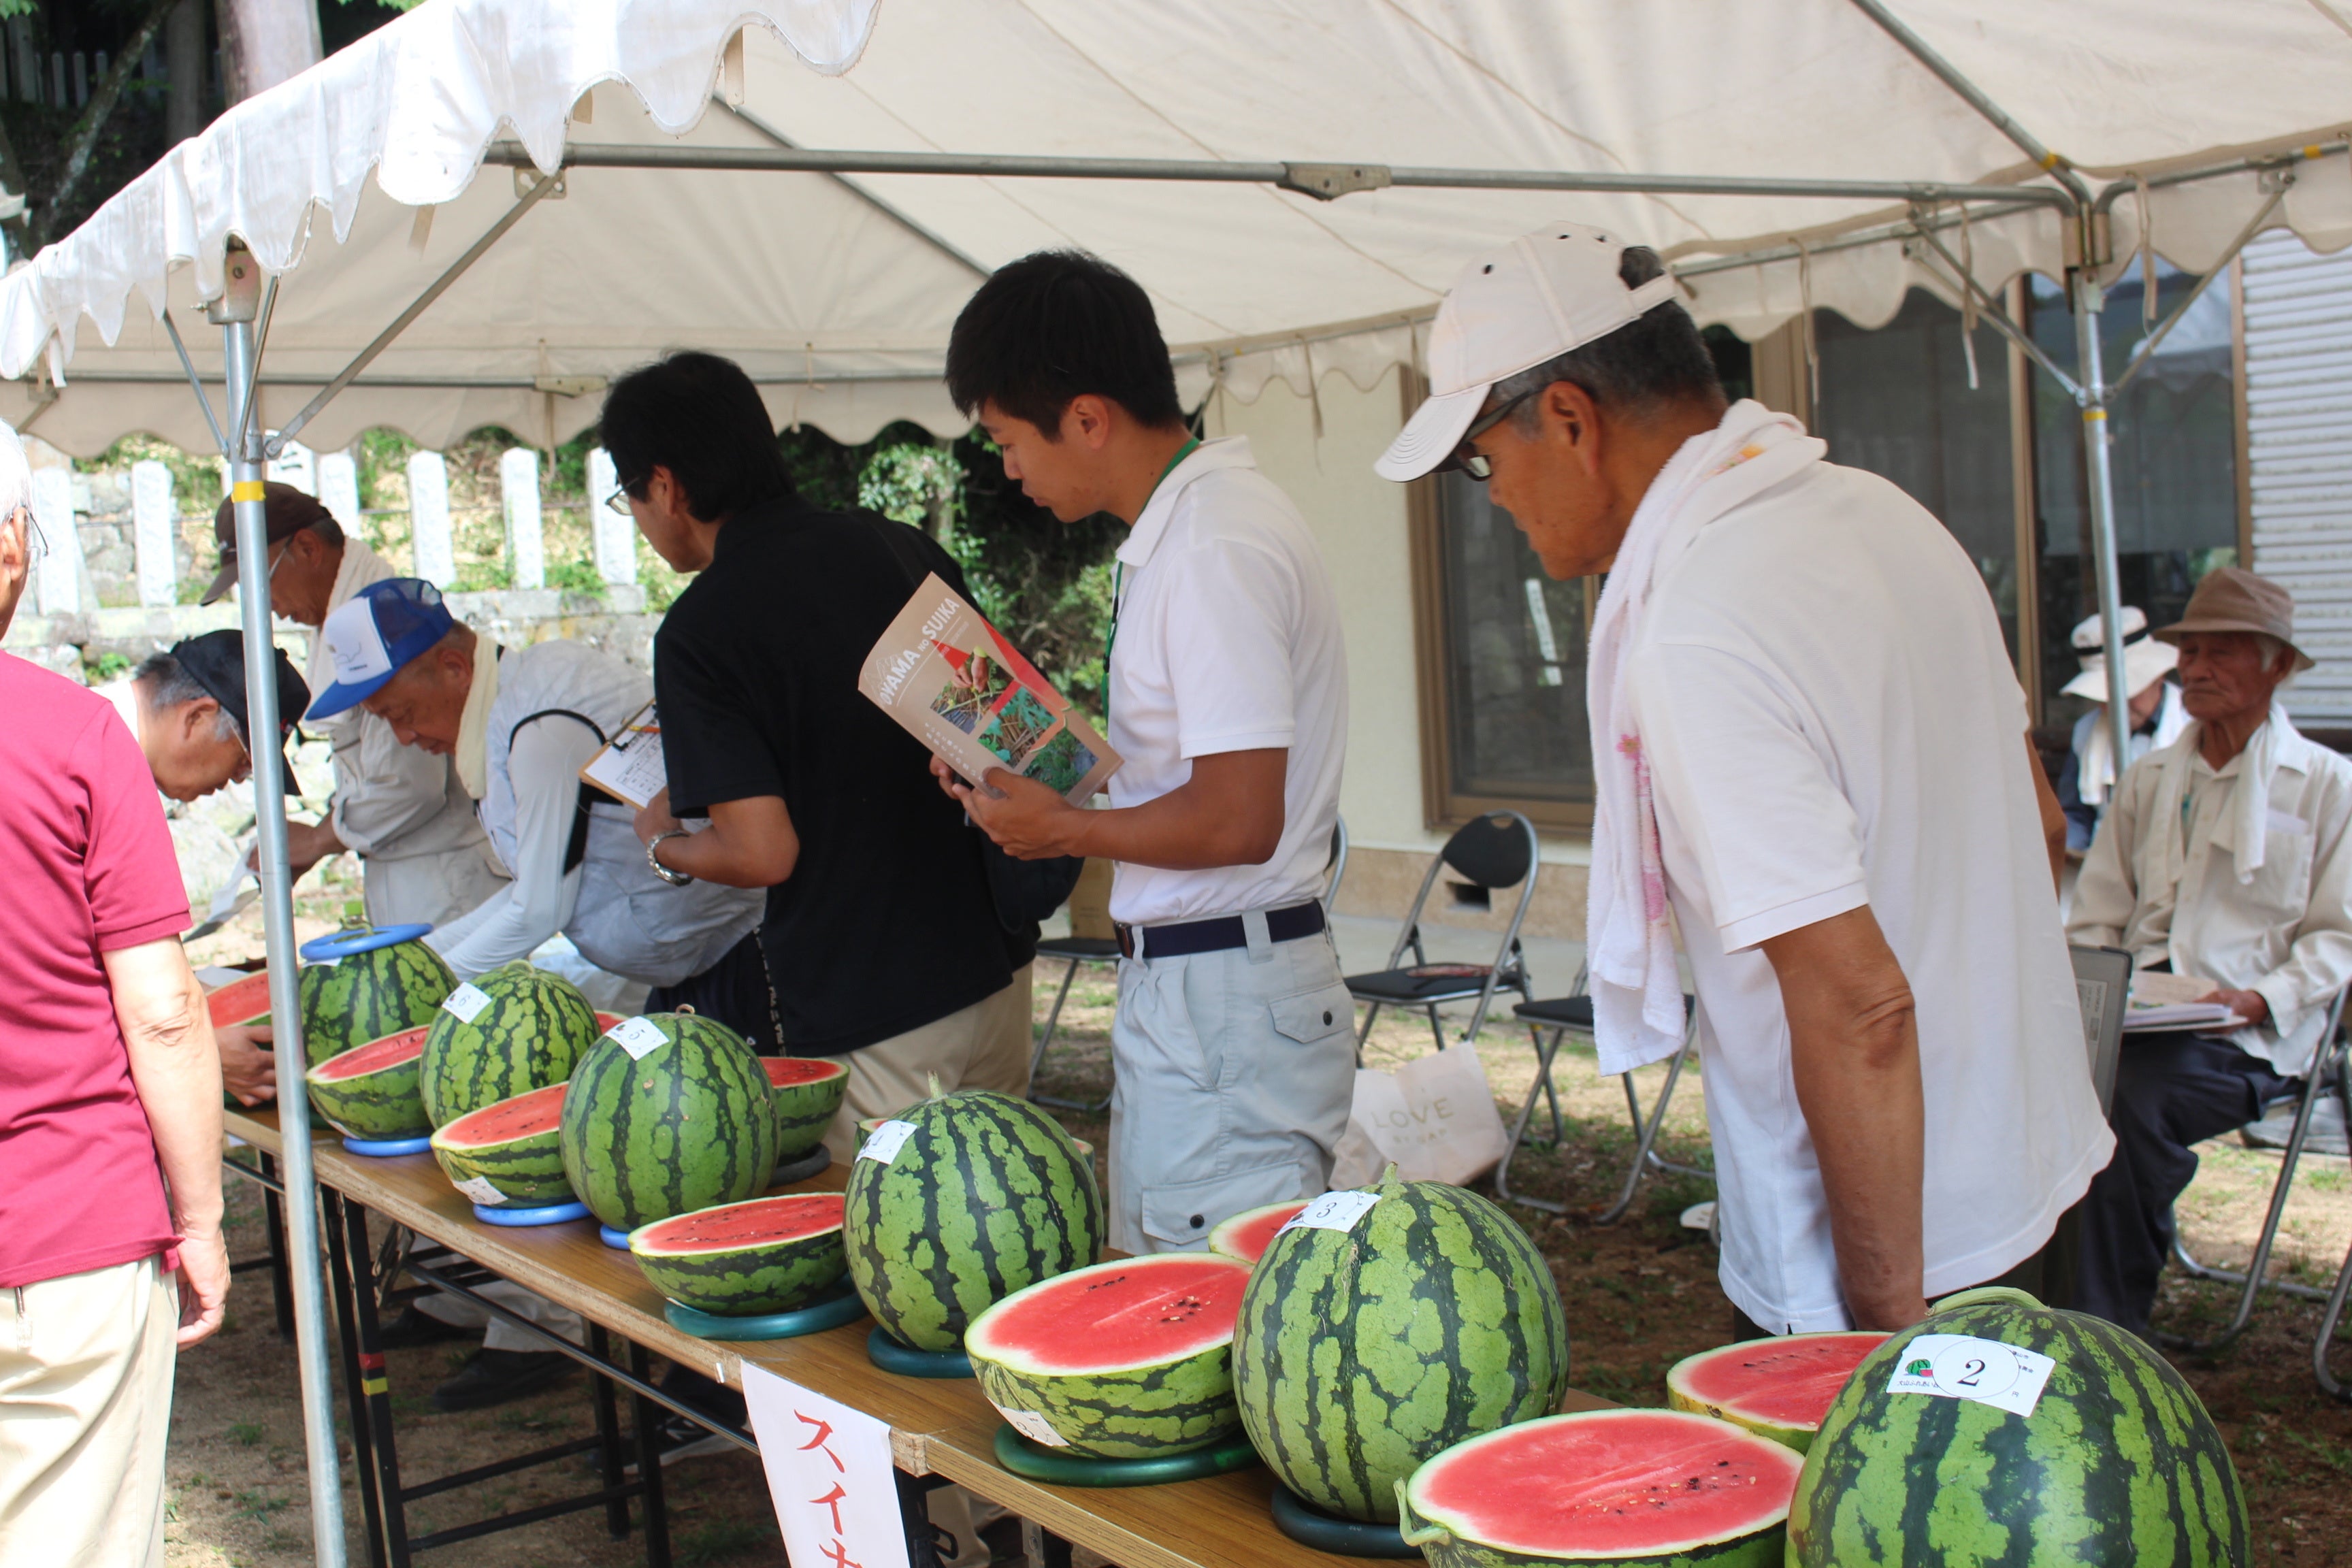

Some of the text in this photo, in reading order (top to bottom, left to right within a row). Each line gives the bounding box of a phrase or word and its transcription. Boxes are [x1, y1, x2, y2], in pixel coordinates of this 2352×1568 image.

[879, 649, 921, 705] OYAMA
[921, 598, 960, 640] SUIKA
[1370, 1096, 1454, 1129] LOVE
[1316, 1202, 1337, 1218] 3
[1957, 1358, 1986, 1387] 2
